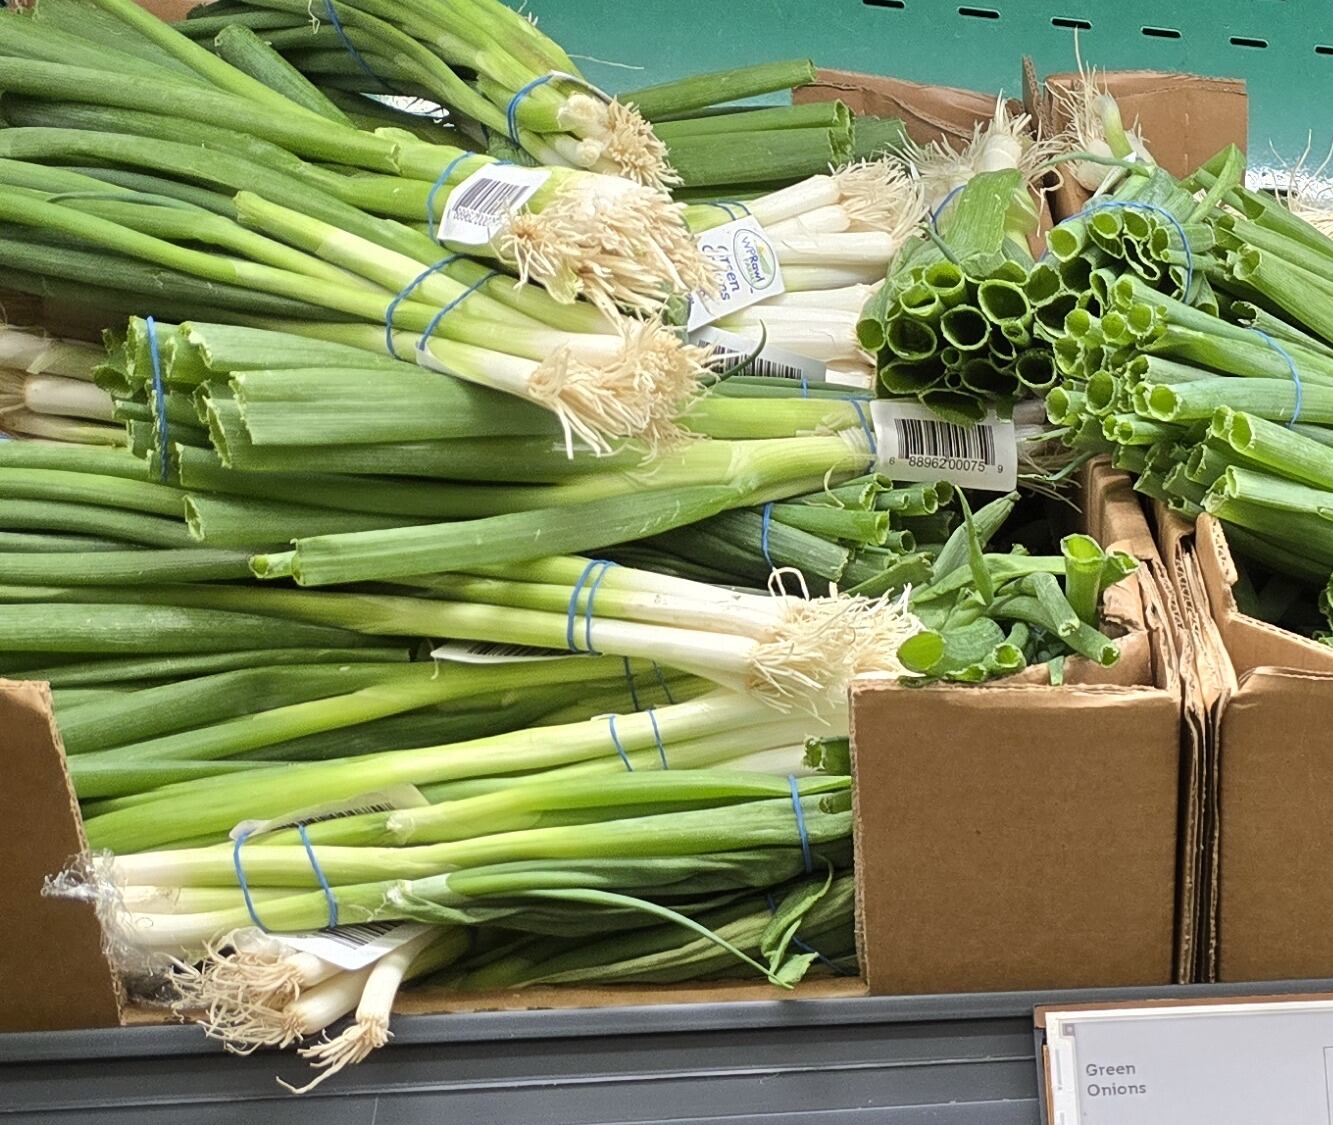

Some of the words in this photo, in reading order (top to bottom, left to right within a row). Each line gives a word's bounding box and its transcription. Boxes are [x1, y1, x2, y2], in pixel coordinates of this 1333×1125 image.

[997, 464, 1004, 474] 9
[1086, 1062, 1137, 1078] Green
[1087, 1081, 1147, 1098] Onions
